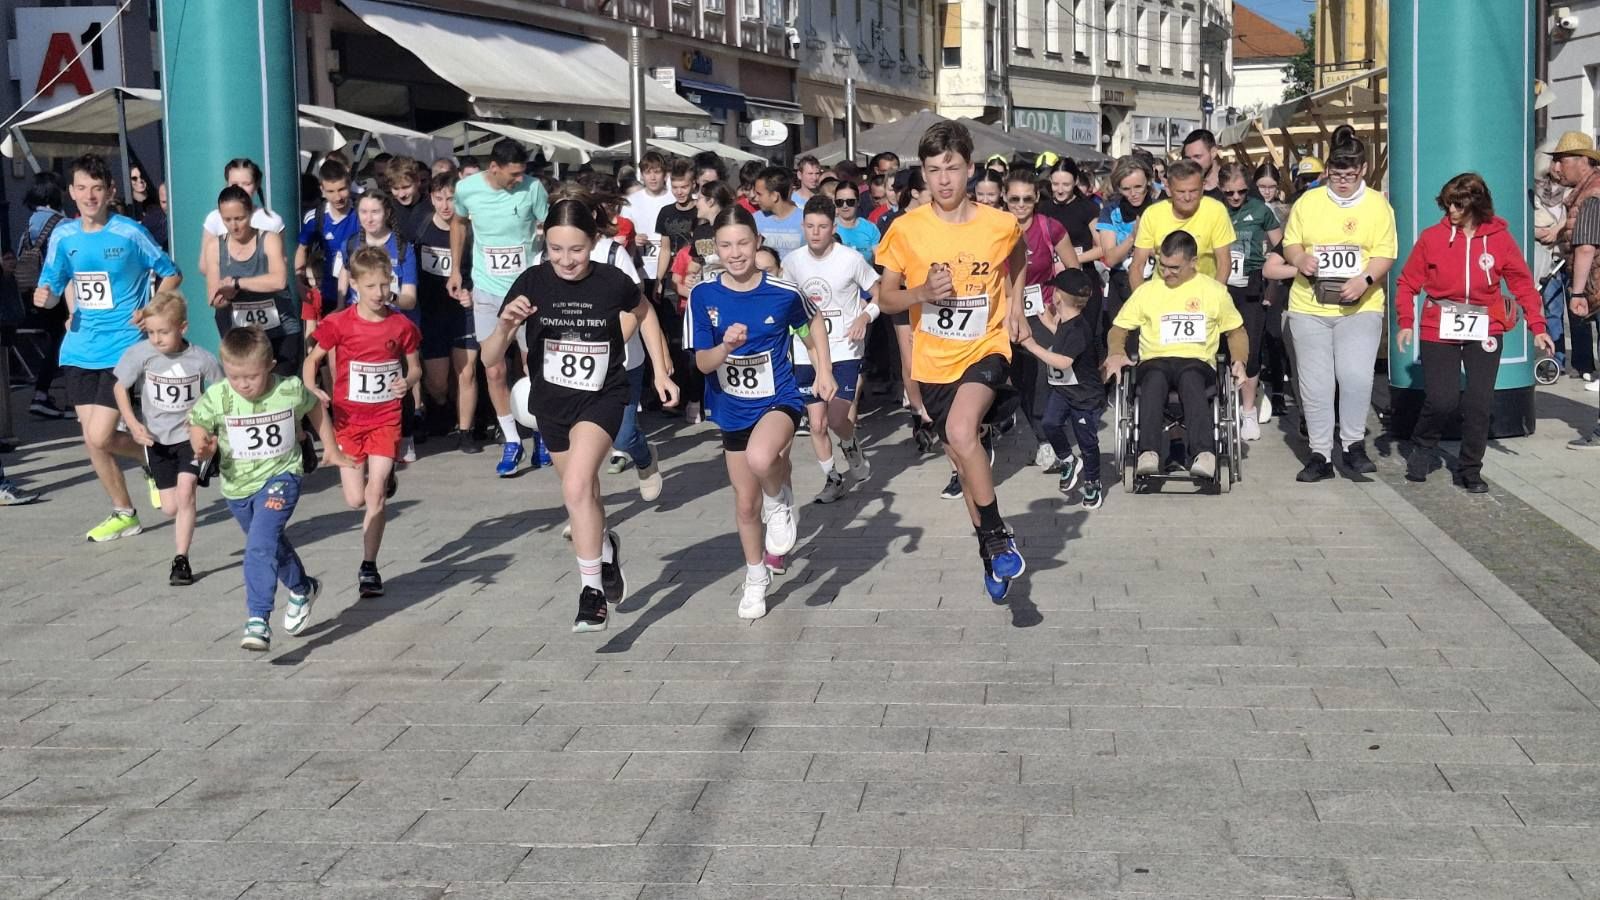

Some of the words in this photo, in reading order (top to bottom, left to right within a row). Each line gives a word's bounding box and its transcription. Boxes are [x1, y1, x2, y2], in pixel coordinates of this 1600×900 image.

[35, 22, 104, 97] A1
[1014, 110, 1062, 135] MODA
[431, 255, 450, 270] 70
[490, 253, 522, 269] 124
[971, 262, 990, 276] 22
[1319, 251, 1356, 269] 300
[246, 310, 268, 324] 48
[577, 319, 585, 327] DI
[587, 319, 607, 327] TREVI
[937, 308, 973, 331] 87
[1453, 314, 1479, 332] 57
[1172, 321, 1195, 336] 78
[561, 354, 596, 380] 89
[726, 366, 758, 389] 88
[153, 382, 196, 403] 191
[246, 424, 283, 450] 38
